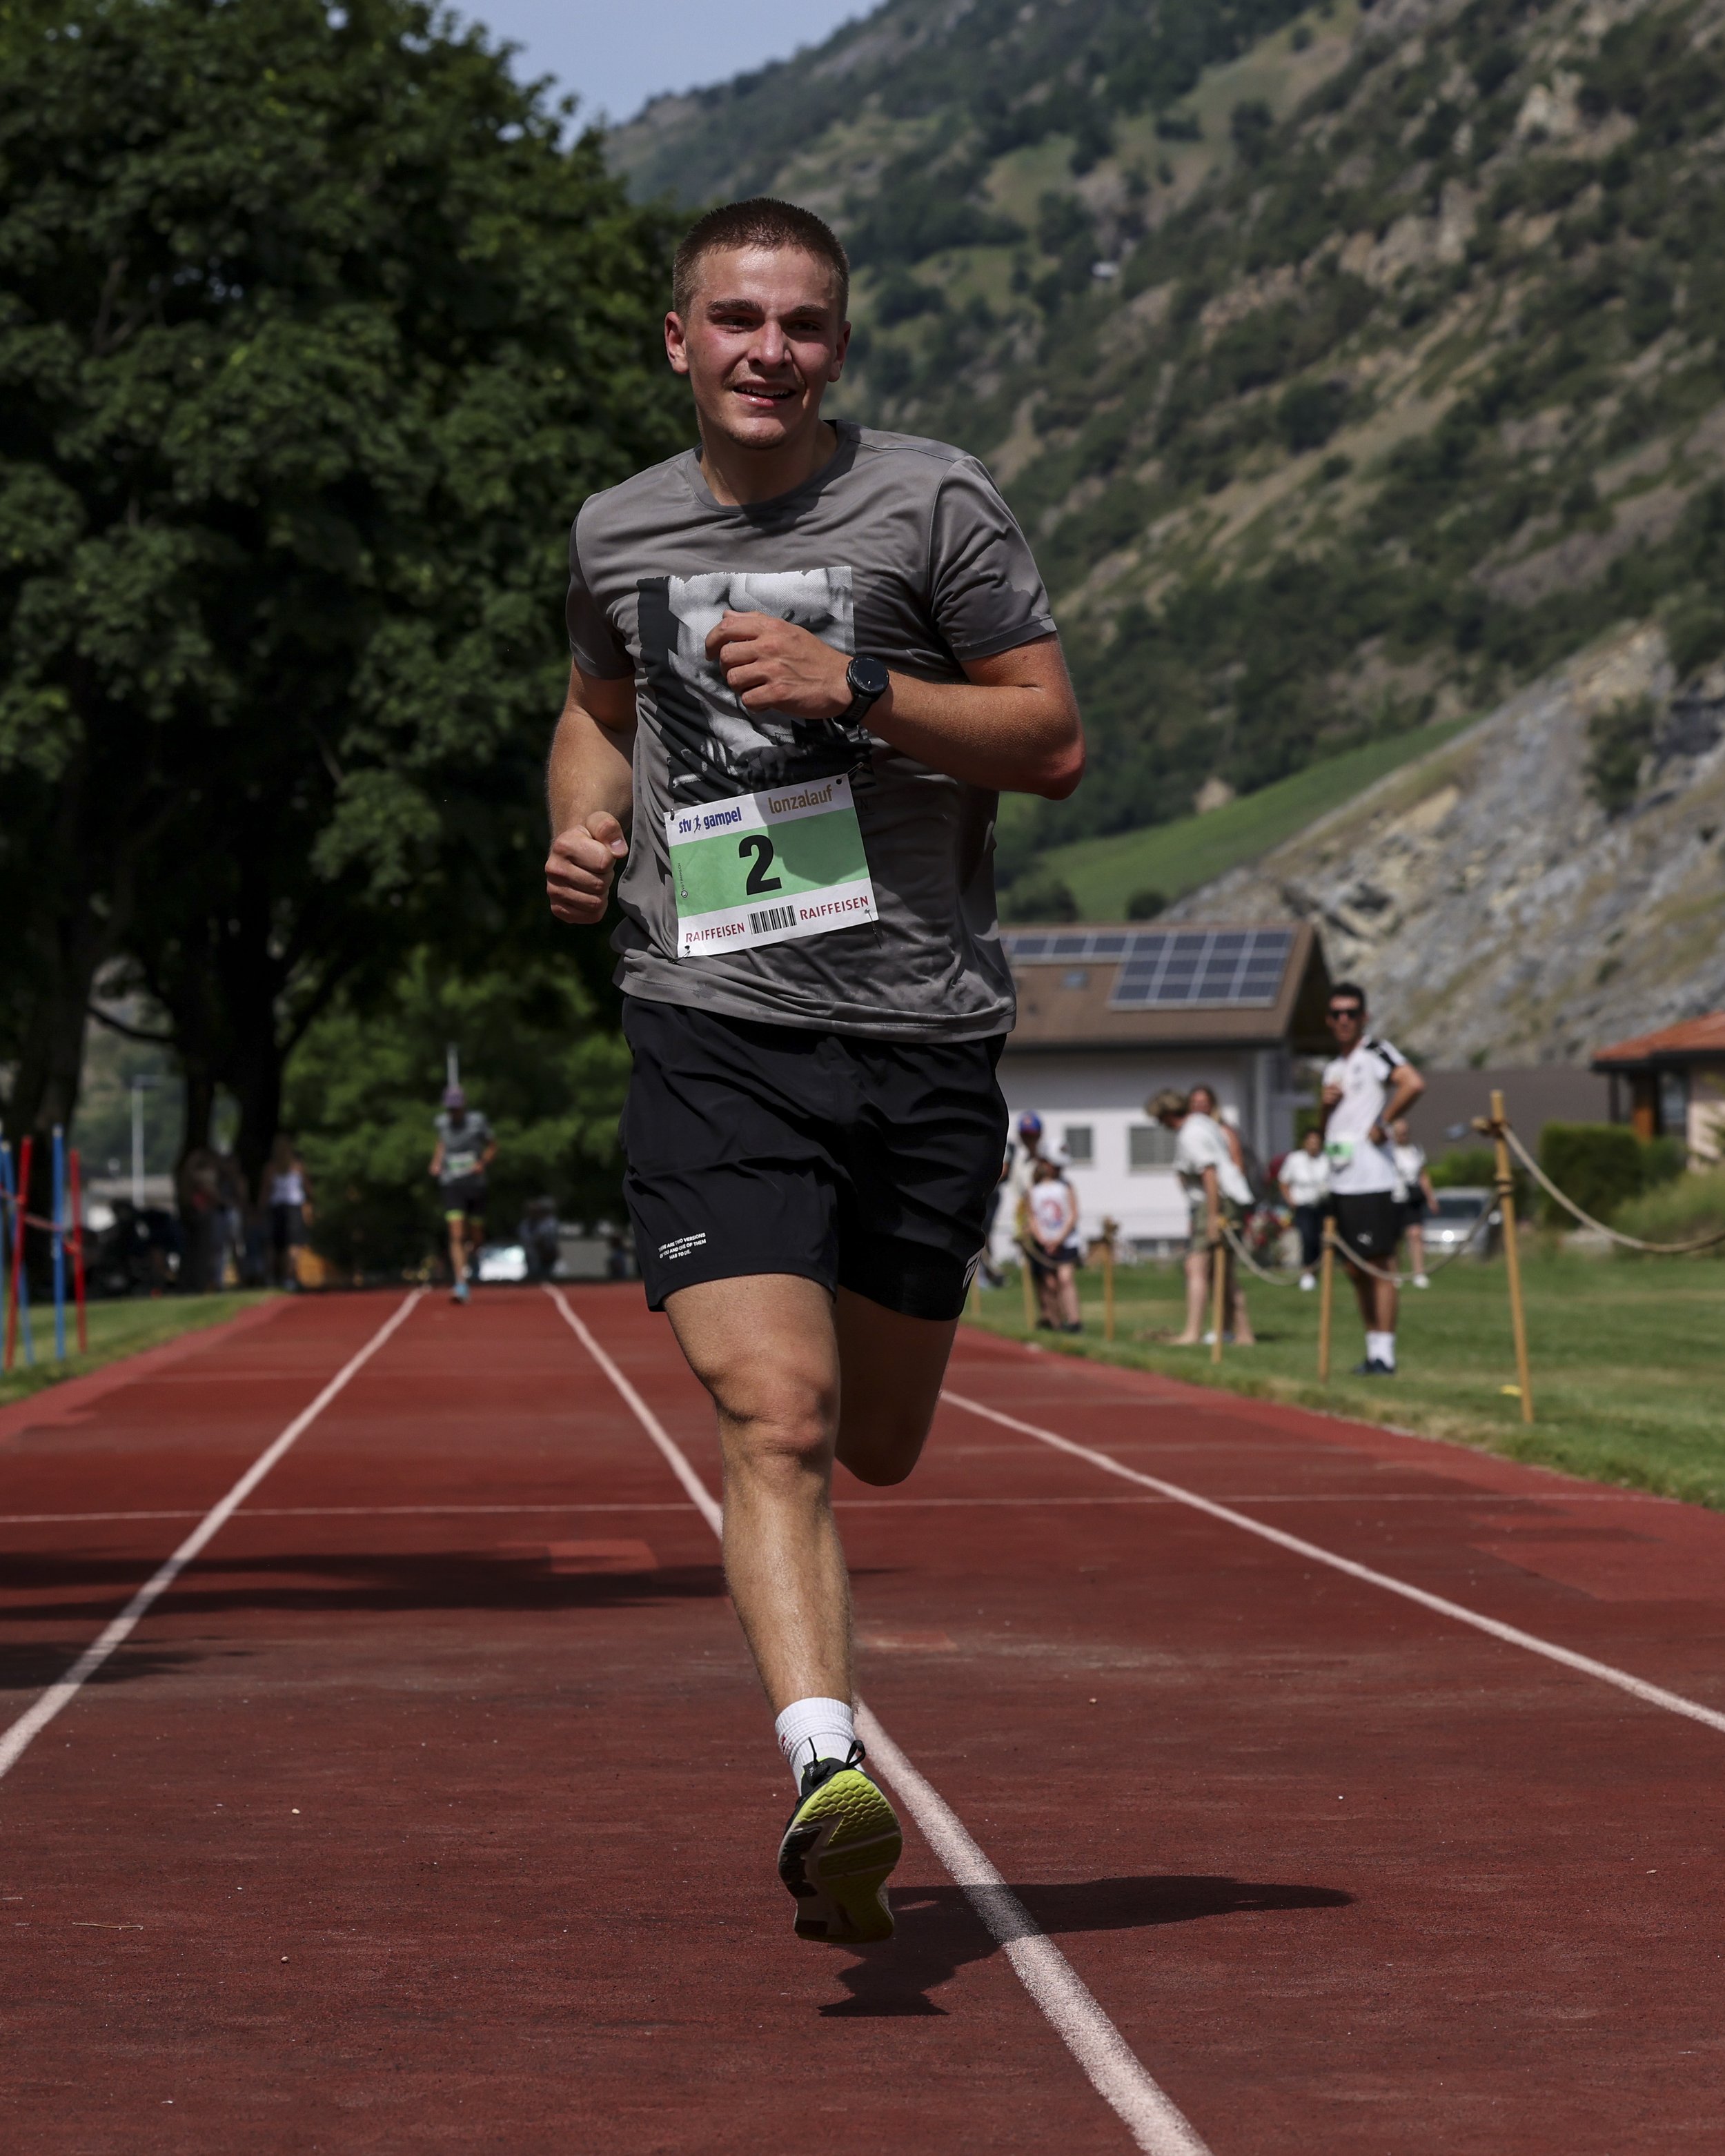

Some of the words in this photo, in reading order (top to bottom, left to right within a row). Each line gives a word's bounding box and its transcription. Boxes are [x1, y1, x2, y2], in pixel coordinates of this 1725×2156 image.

[768, 784, 833, 814] lonzalauf
[679, 815, 691, 833] stv
[703, 807, 742, 830] gampel
[738, 834, 782, 896] 2
[800, 896, 869, 921] RAIFFEISEN
[685, 922, 745, 942] RAIFFEISEN
[683, 1232, 706, 1242] VERSIONS
